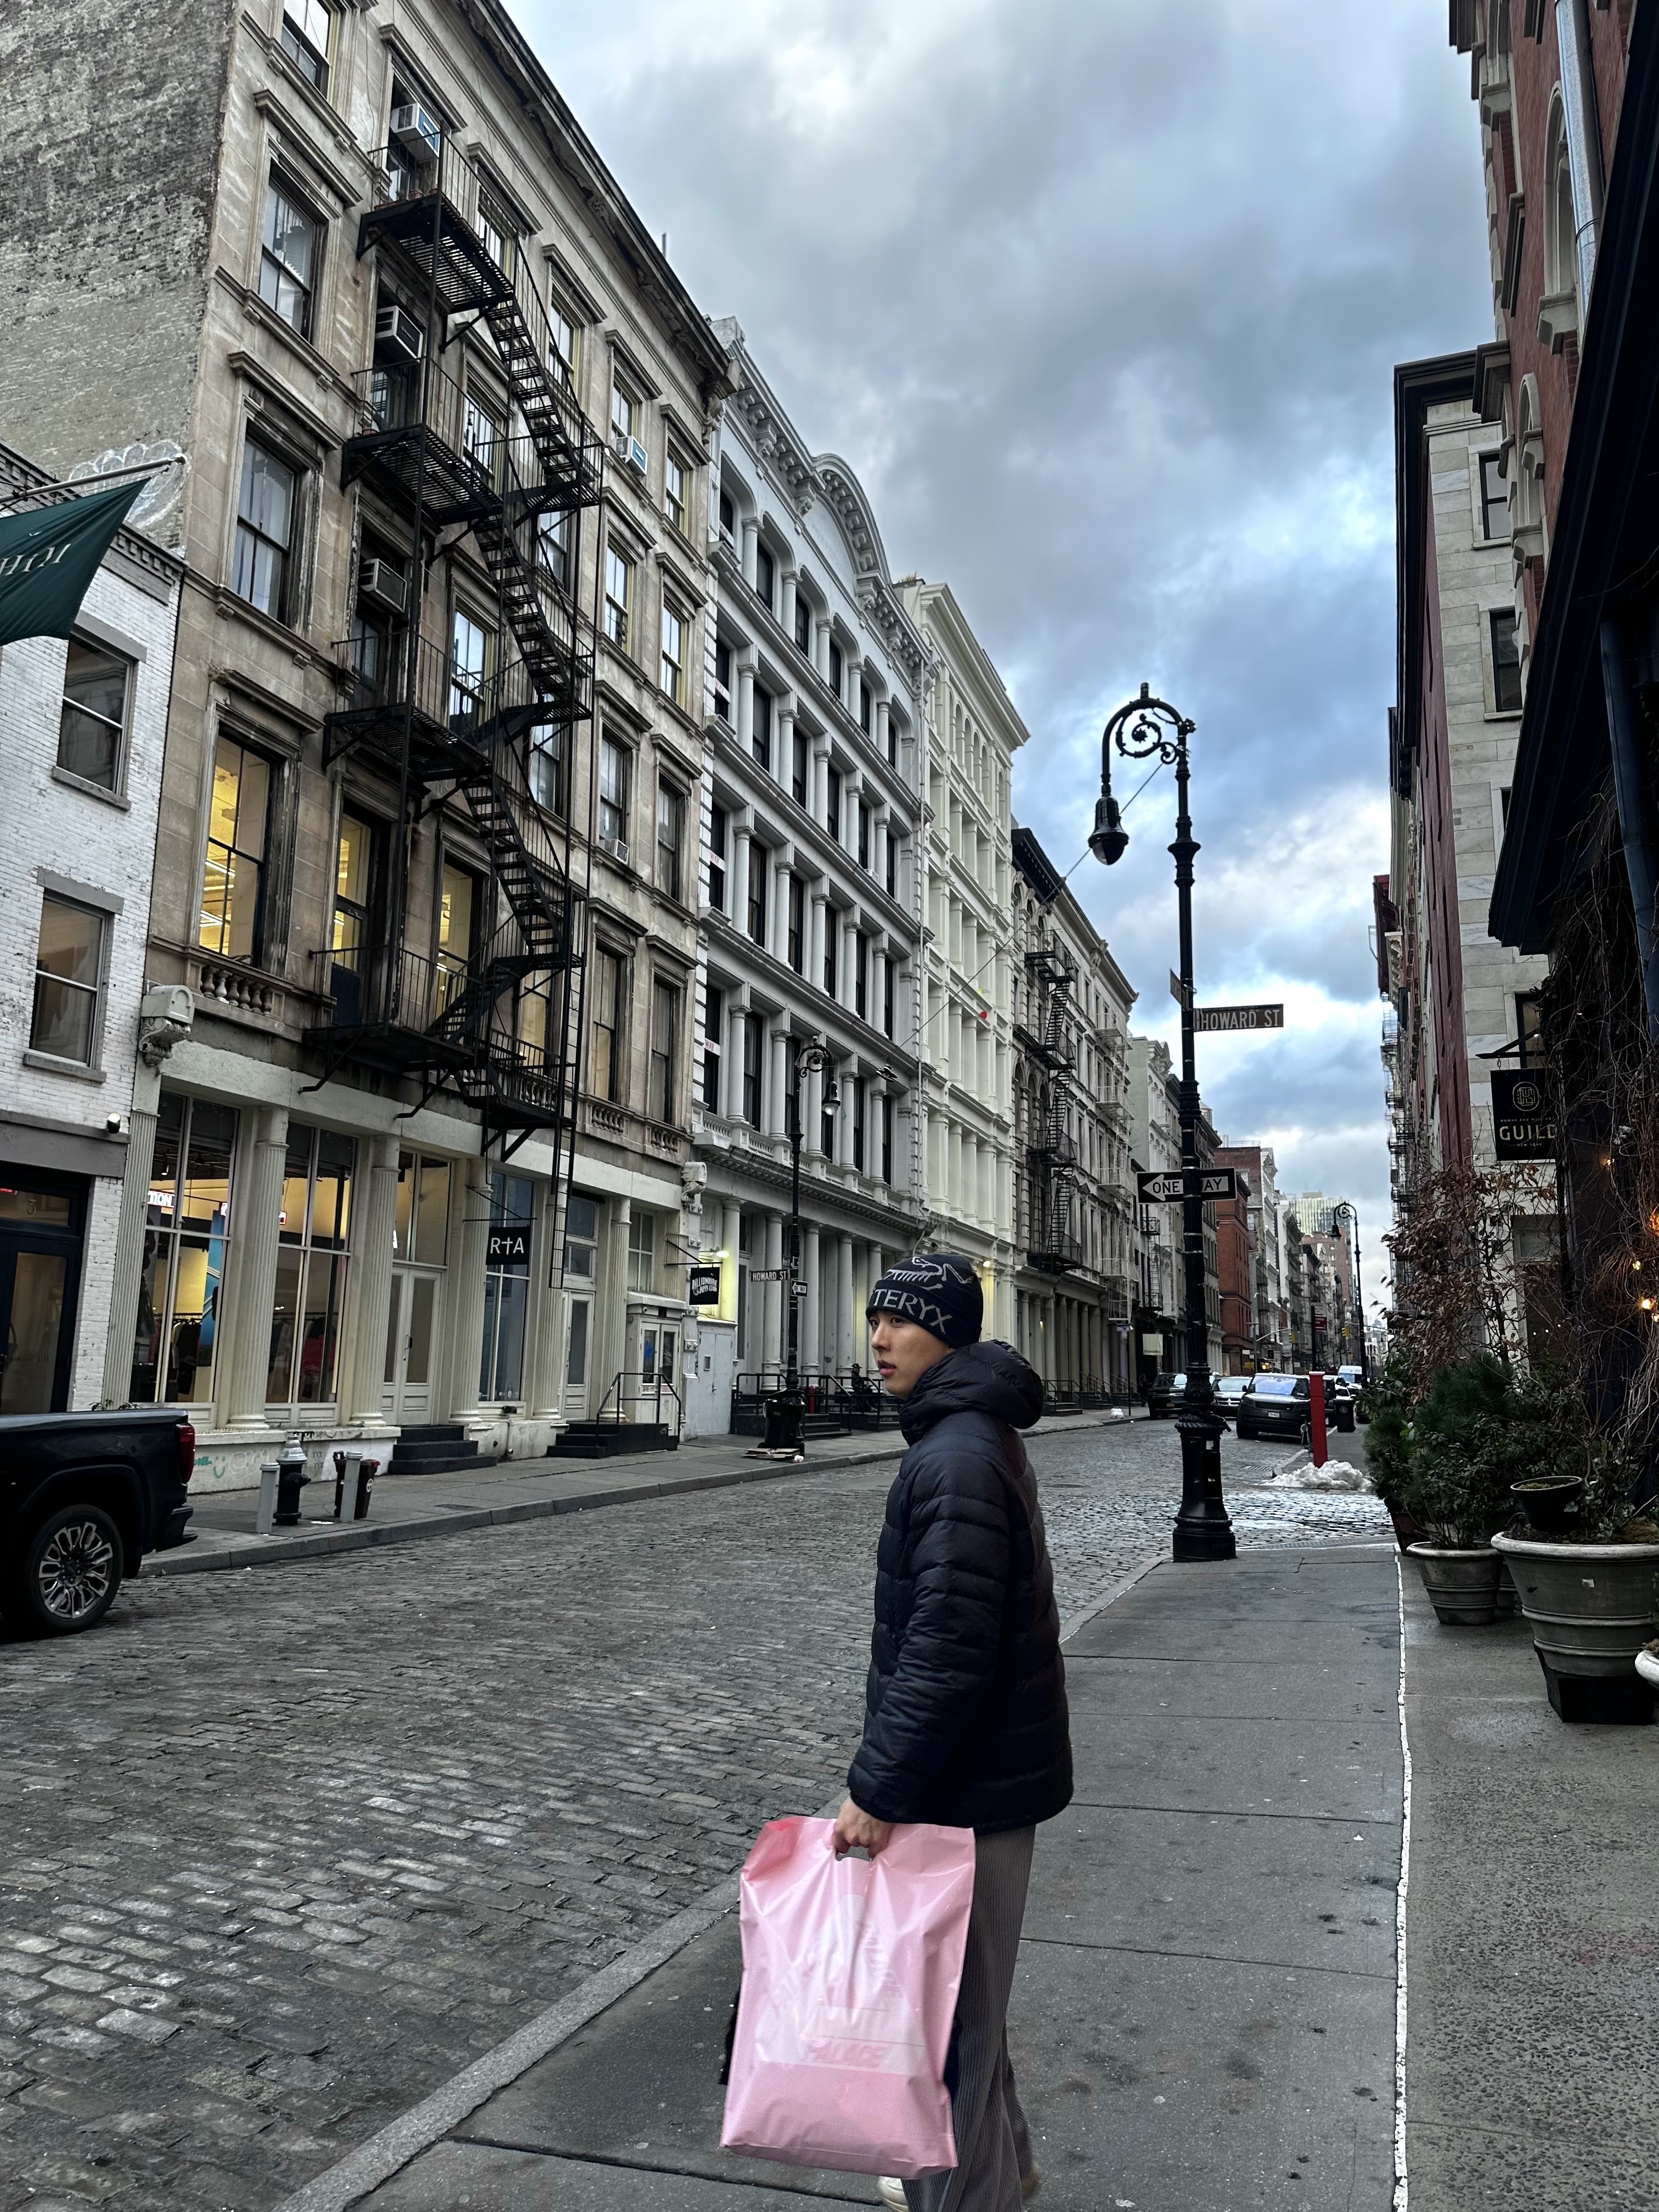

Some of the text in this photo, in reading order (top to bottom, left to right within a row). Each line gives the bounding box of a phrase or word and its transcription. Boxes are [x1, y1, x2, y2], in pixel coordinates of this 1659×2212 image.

[1201, 1009, 1280, 1030] HOWARD ST
[1499, 1124, 1558, 1141] GUILD
[1153, 1178, 1222, 1194] ONE AY
[753, 1271, 787, 1281] HOWARD ST
